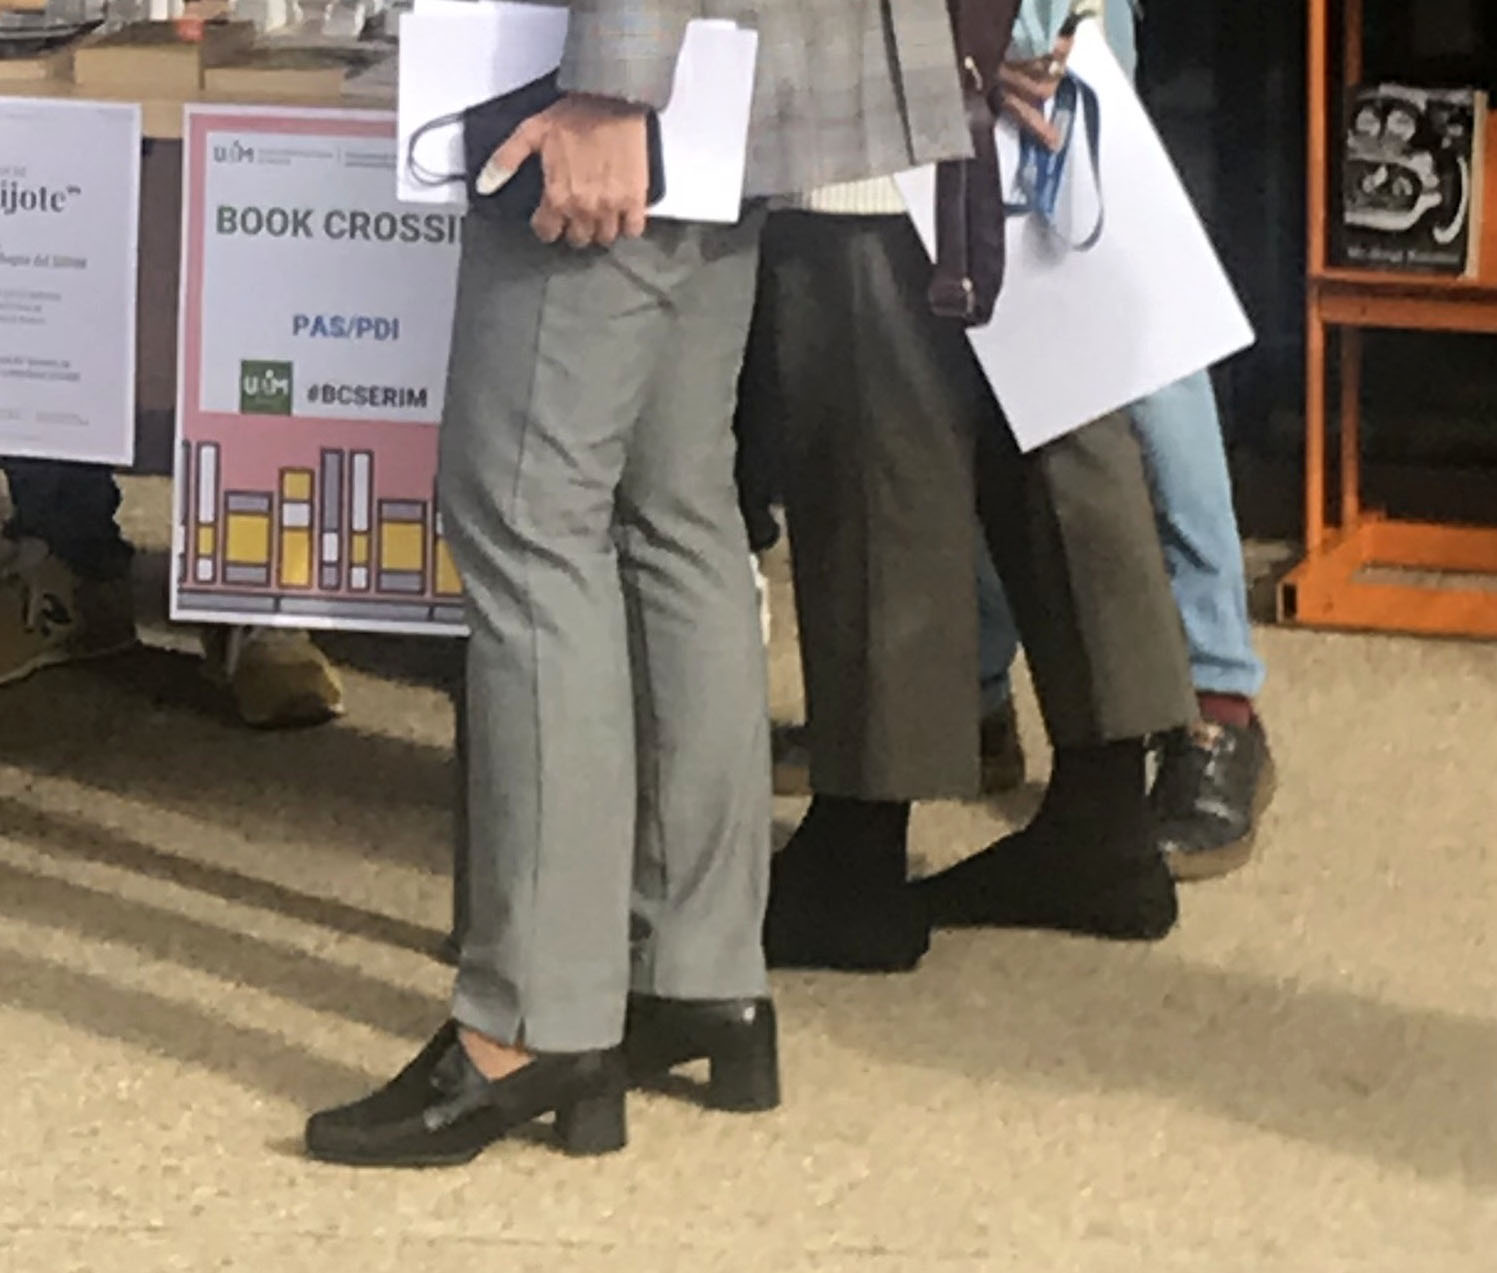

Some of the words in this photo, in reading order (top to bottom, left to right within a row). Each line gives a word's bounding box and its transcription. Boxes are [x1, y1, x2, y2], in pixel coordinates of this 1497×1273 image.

[216, 205, 314, 239] BOOK
[323, 212, 466, 245] CROSSI
[292, 314, 401, 341] PAS/PDI
[306, 383, 429, 409] #BCSERIM
